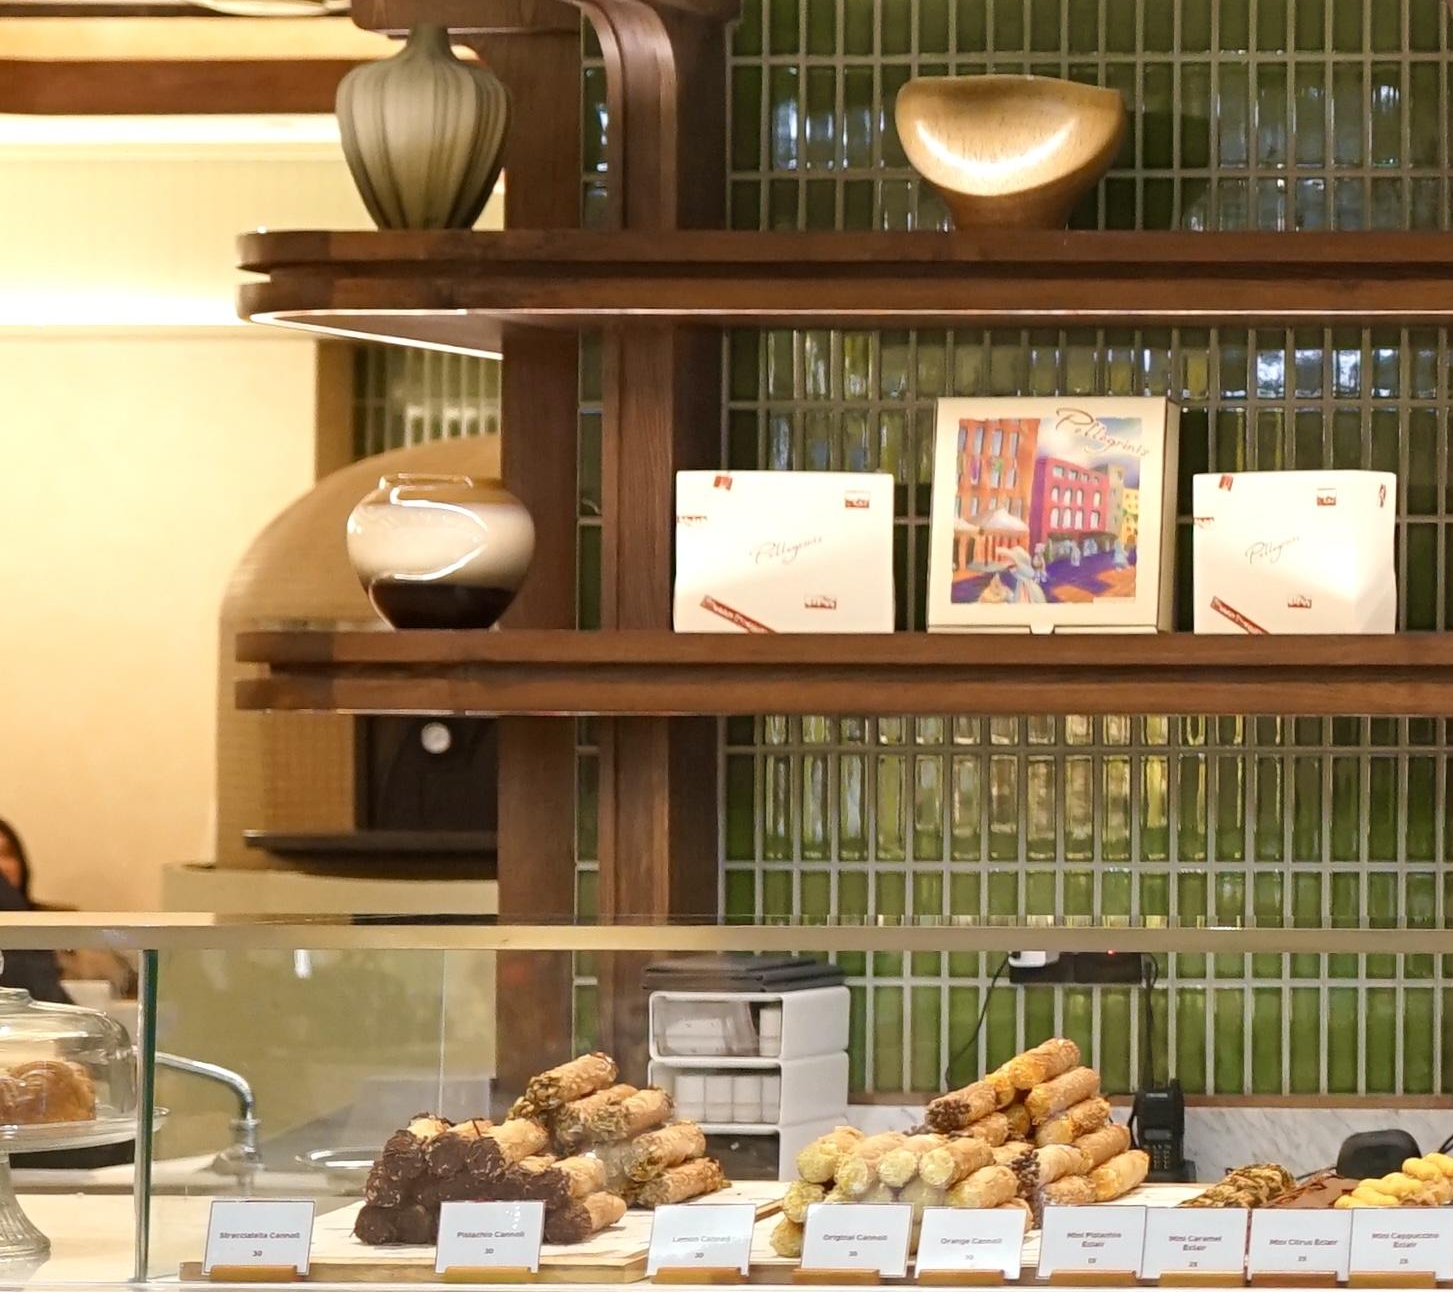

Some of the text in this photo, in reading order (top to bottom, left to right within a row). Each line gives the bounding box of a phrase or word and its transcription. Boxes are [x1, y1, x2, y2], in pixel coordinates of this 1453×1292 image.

[269, 1231, 301, 1239] Cannoli
[822, 1234, 855, 1242] Original
[940, 1237, 971, 1246] Orange
